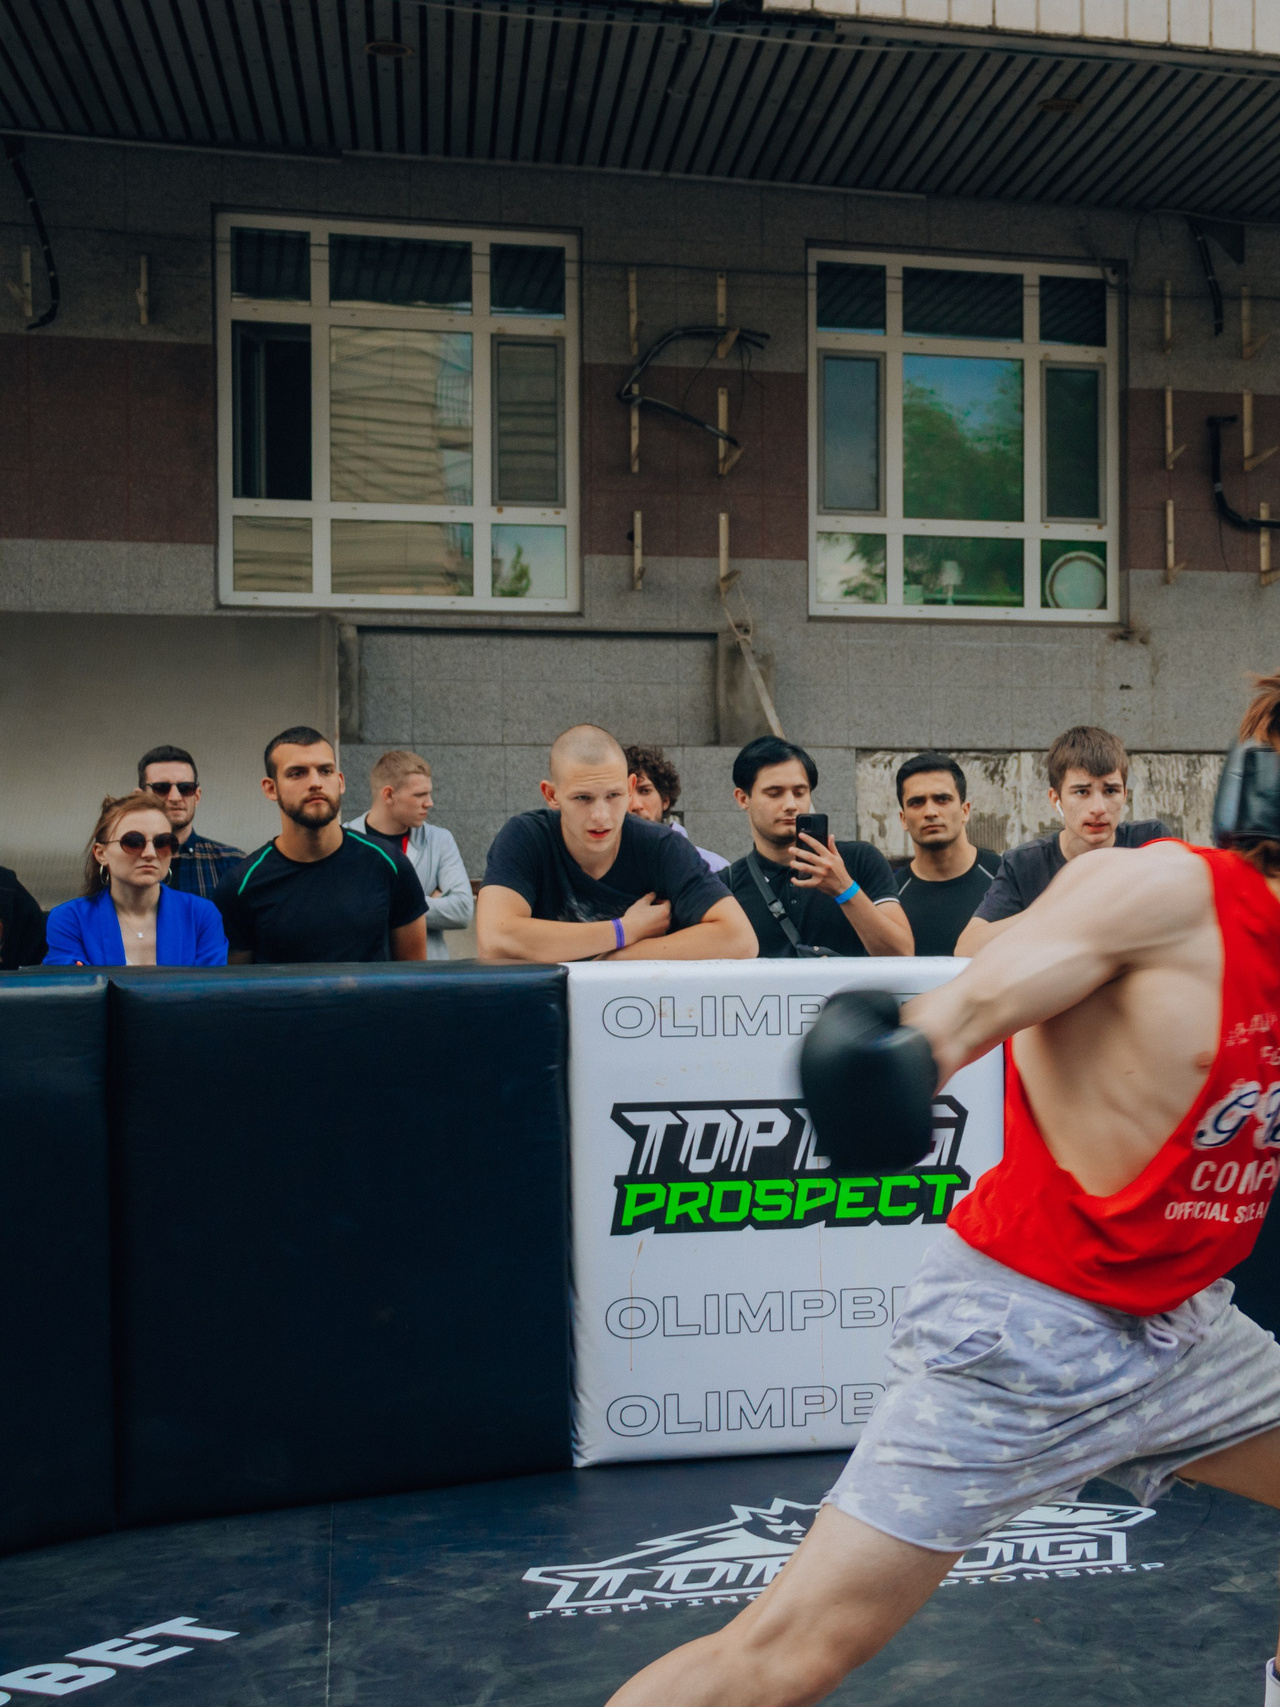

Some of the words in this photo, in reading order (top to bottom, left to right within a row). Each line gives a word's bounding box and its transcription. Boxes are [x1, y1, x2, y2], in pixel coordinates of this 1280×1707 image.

[602, 993, 922, 1038] OLIMP
[621, 1107, 792, 1175] TOP
[621, 1174, 962, 1227] PROSPECT
[1164, 1201, 1230, 1223] OFFICIAL
[605, 1285, 906, 1339] OLIMPB
[606, 1383, 887, 1437] OLIMPB
[938, 1562, 1165, 1588] PIONSHIP
[0, 1616, 241, 1707] BET
